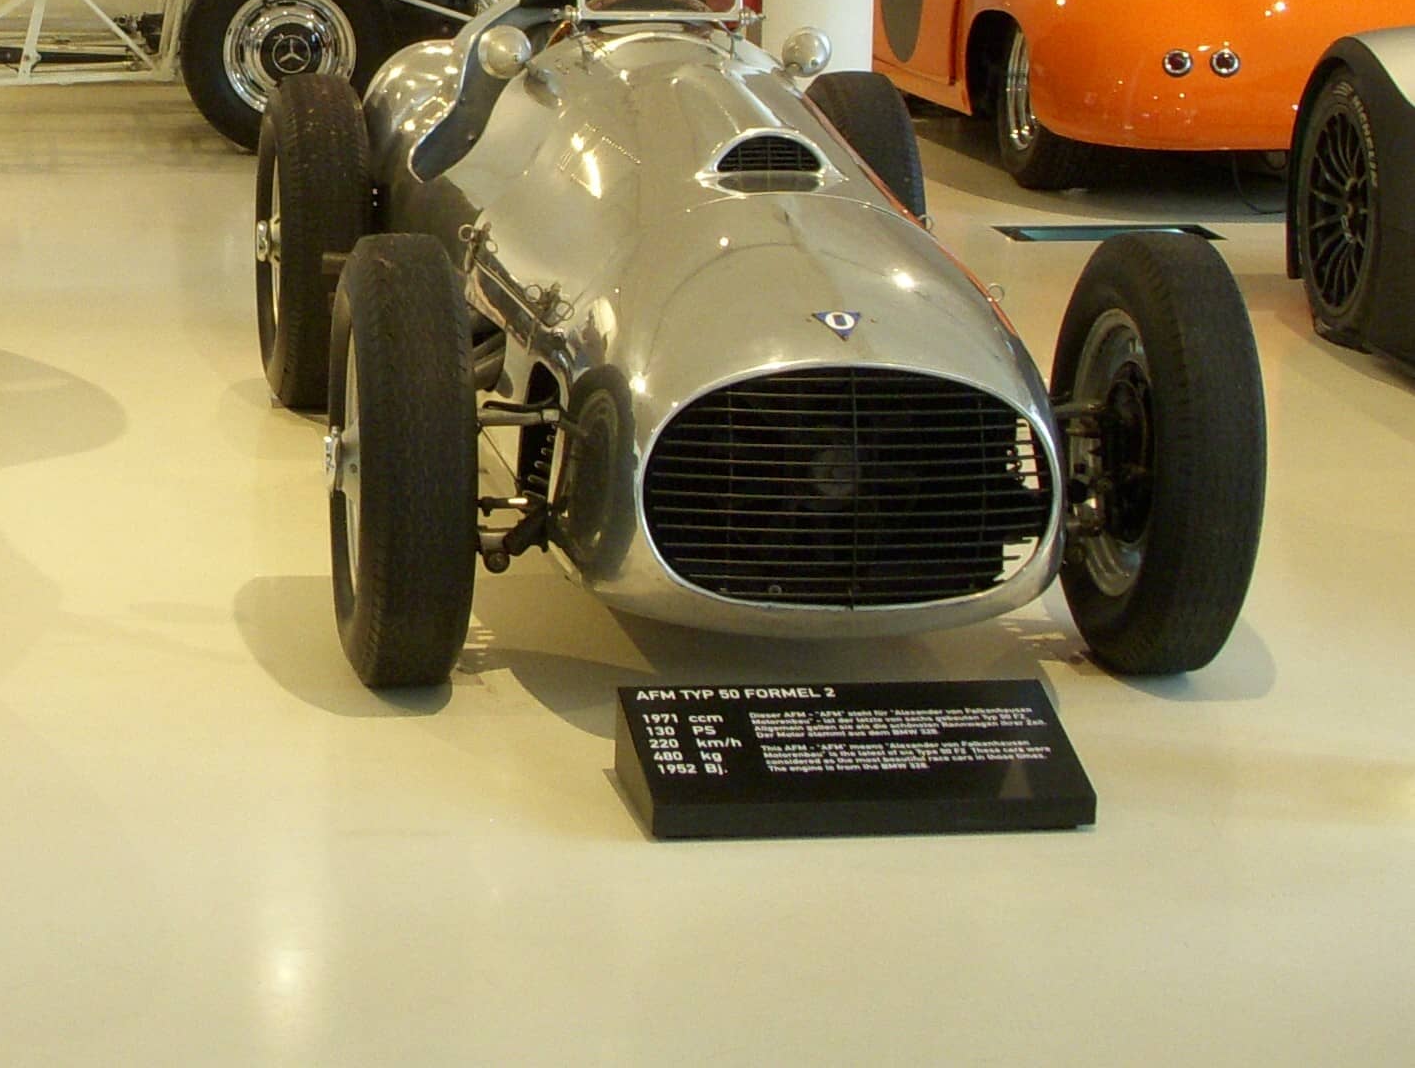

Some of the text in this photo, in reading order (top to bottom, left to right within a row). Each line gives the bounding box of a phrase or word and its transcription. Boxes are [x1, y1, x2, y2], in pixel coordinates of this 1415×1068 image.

[636, 687, 836, 701] AFM TYP 50 FORMEL 2
[642, 713, 724, 724] 1971 ccm
[646, 725, 717, 736] 130 PS
[649, 737, 743, 749] 220 km/h
[653, 751, 722, 763] 480 kg
[657, 763, 729, 776] 1952 Bj.
